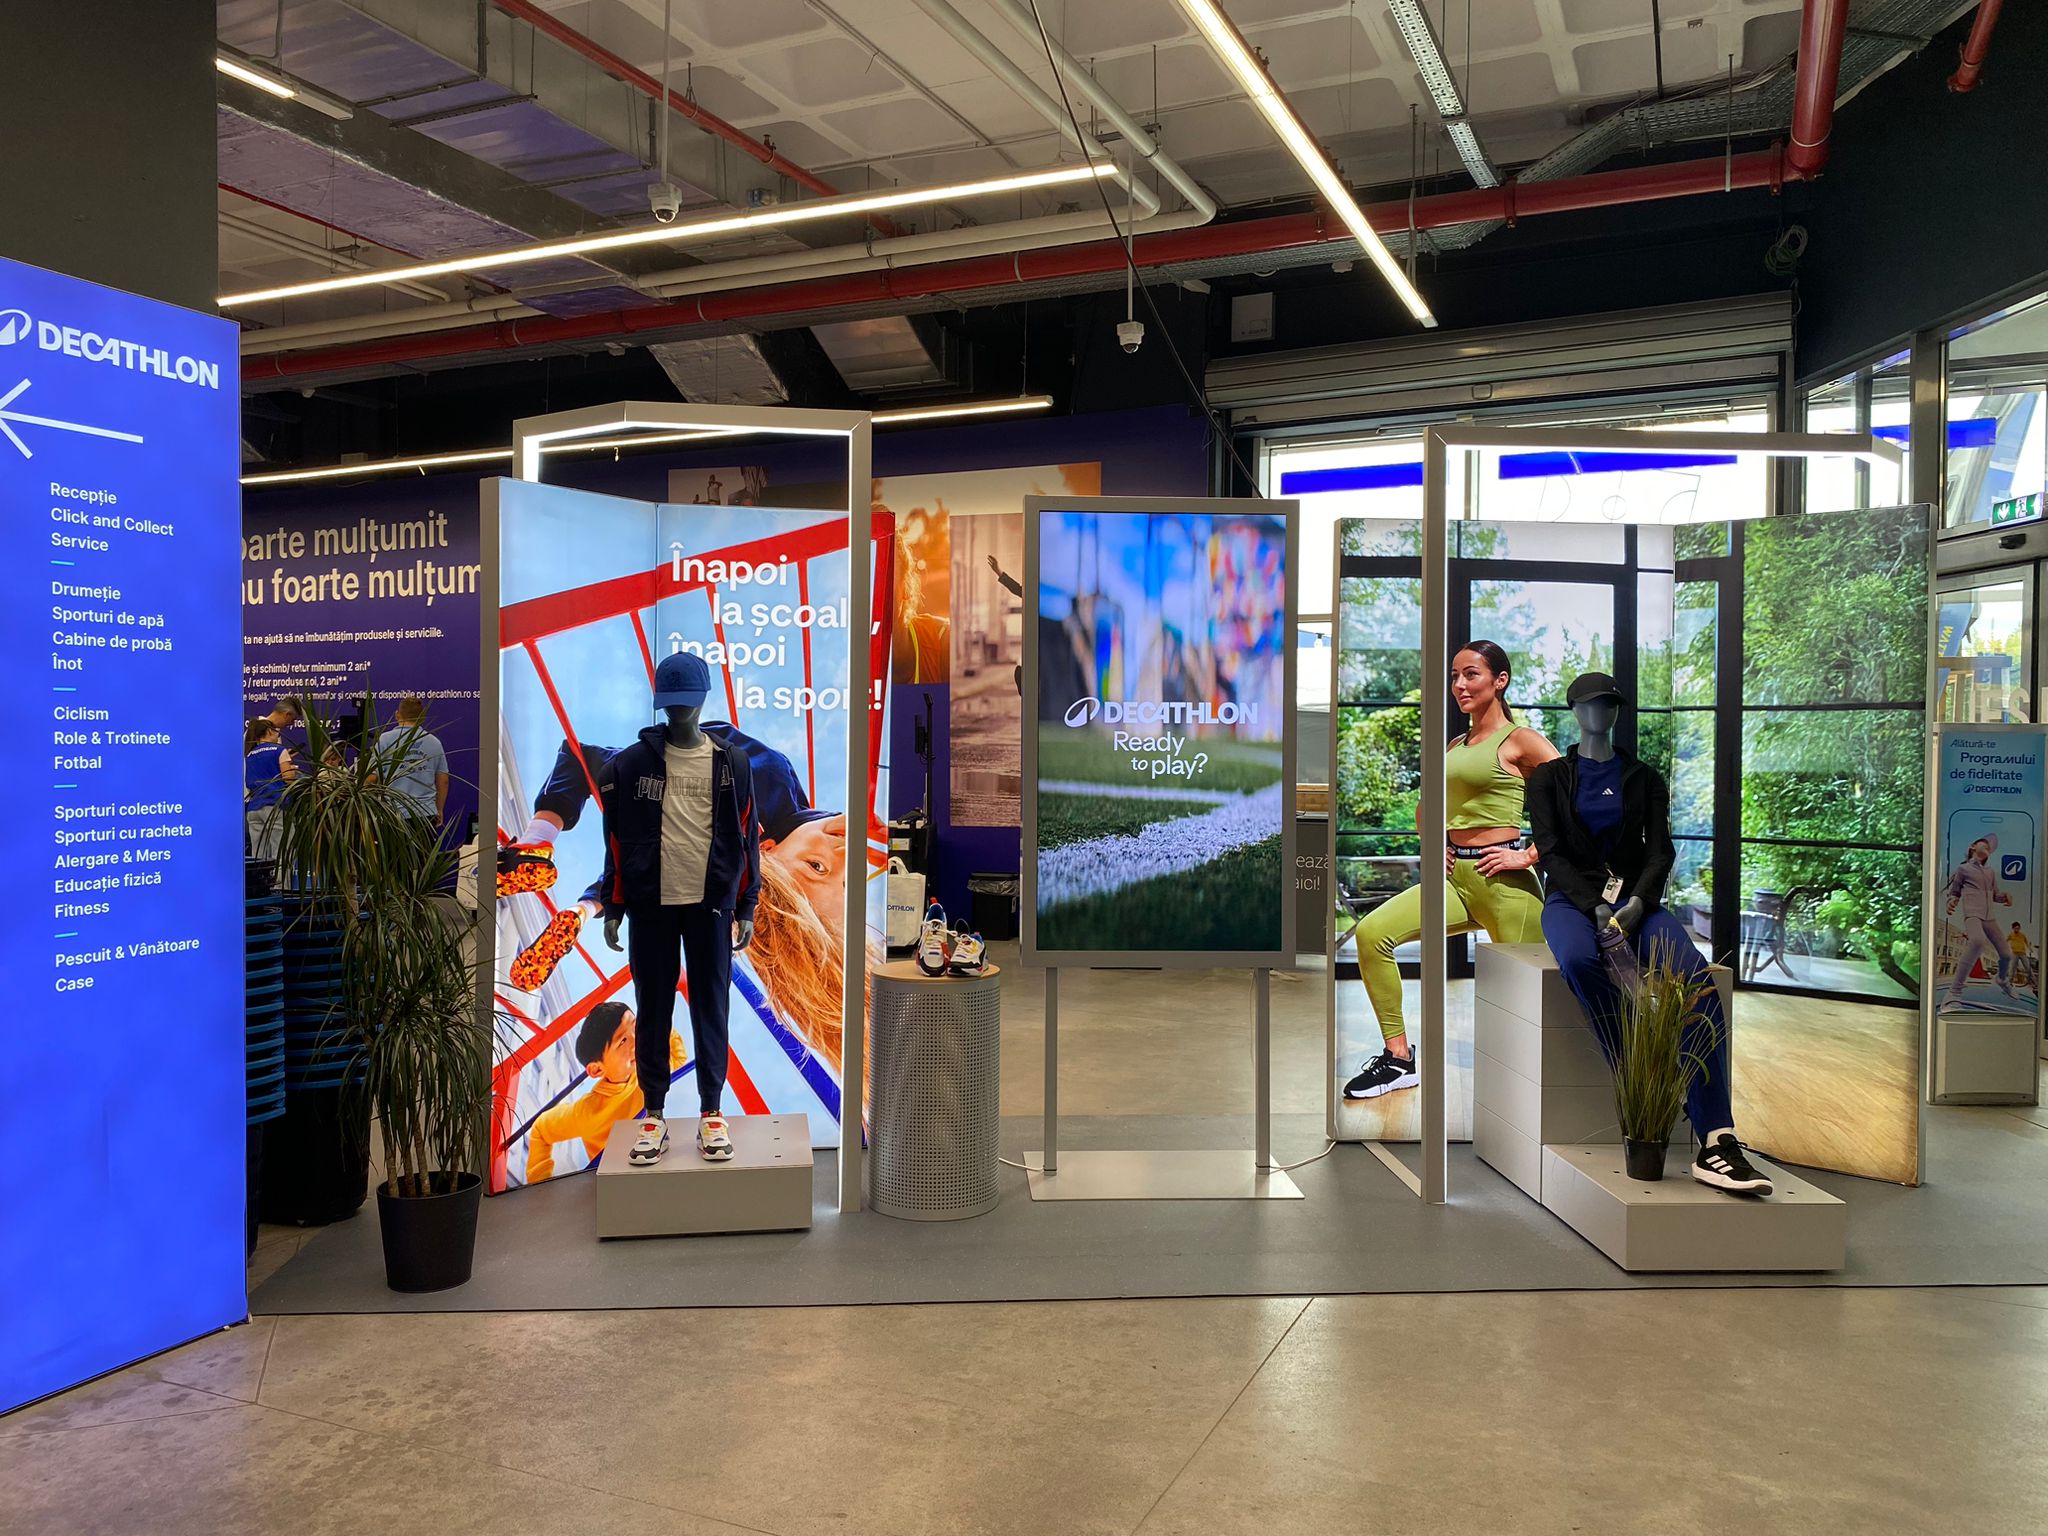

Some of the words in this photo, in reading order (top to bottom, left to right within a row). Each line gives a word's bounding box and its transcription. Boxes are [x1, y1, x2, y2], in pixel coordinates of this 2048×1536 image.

[38, 320, 219, 390] DECATHLON
[50, 482, 117, 507] Recepție
[51, 507, 89, 527] Click
[93, 512, 120, 529] and
[124, 517, 174, 536] Collect
[51, 532, 109, 552] Service
[314, 510, 448, 563] mulțumit
[669, 542, 788, 591] Înapoi
[52, 581, 121, 604] Drumeție
[271, 567, 360, 604] foarte
[52, 606, 113, 627] Sporturi
[117, 611, 135, 626] de
[139, 613, 164, 631] apă
[713, 593, 744, 625] la
[750, 597, 881, 636] școal,
[52, 631, 106, 648] Cabine
[109, 633, 128, 649] de
[132, 635, 172, 653] probă
[253, 635, 263, 645] ne
[294, 634, 304, 643] ne
[354, 629, 395, 642] produsele
[404, 627, 444, 639] serviciile.
[52, 653, 83, 671] Înot
[668, 632, 785, 672] înapoi
[347, 661, 353, 671] 2
[252, 677, 272, 688] retur
[320, 676, 326, 686] 2
[736, 677, 766, 709] la
[54, 706, 109, 721] Ciclism
[1104, 702, 1258, 724] DECATHLON
[54, 731, 88, 745] Role
[91, 732, 101, 745] &
[105, 731, 170, 745] Trotinete
[1114, 731, 1185, 756] Ready
[54, 755, 102, 769] Fotbal
[1131, 757, 1148, 771] to
[1151, 753, 1208, 779] play?
[1960, 752, 2036, 766] Programului
[1950, 768, 1966, 779] de
[1968, 769, 2023, 781] fidelitate
[1975, 785, 2022, 794] DECATHLON
[54, 803, 115, 822] Sporturi
[119, 801, 183, 816] colective
[54, 828, 115, 847] Sporturi
[119, 829, 137, 840] cu
[140, 824, 192, 839] racheta
[54, 852, 119, 871] Alergare
[122, 850, 133, 864] &
[136, 849, 171, 863] Mers
[54, 875, 120, 894] Educație
[123, 872, 162, 887] fizică
[54, 901, 110, 918] Fitness
[887, 904, 915, 912] CATHLON
[55, 947, 112, 968] Pescuit
[115, 945, 125, 960] &
[128, 938, 200, 958] Vânătoare
[55, 975, 94, 993] Case
